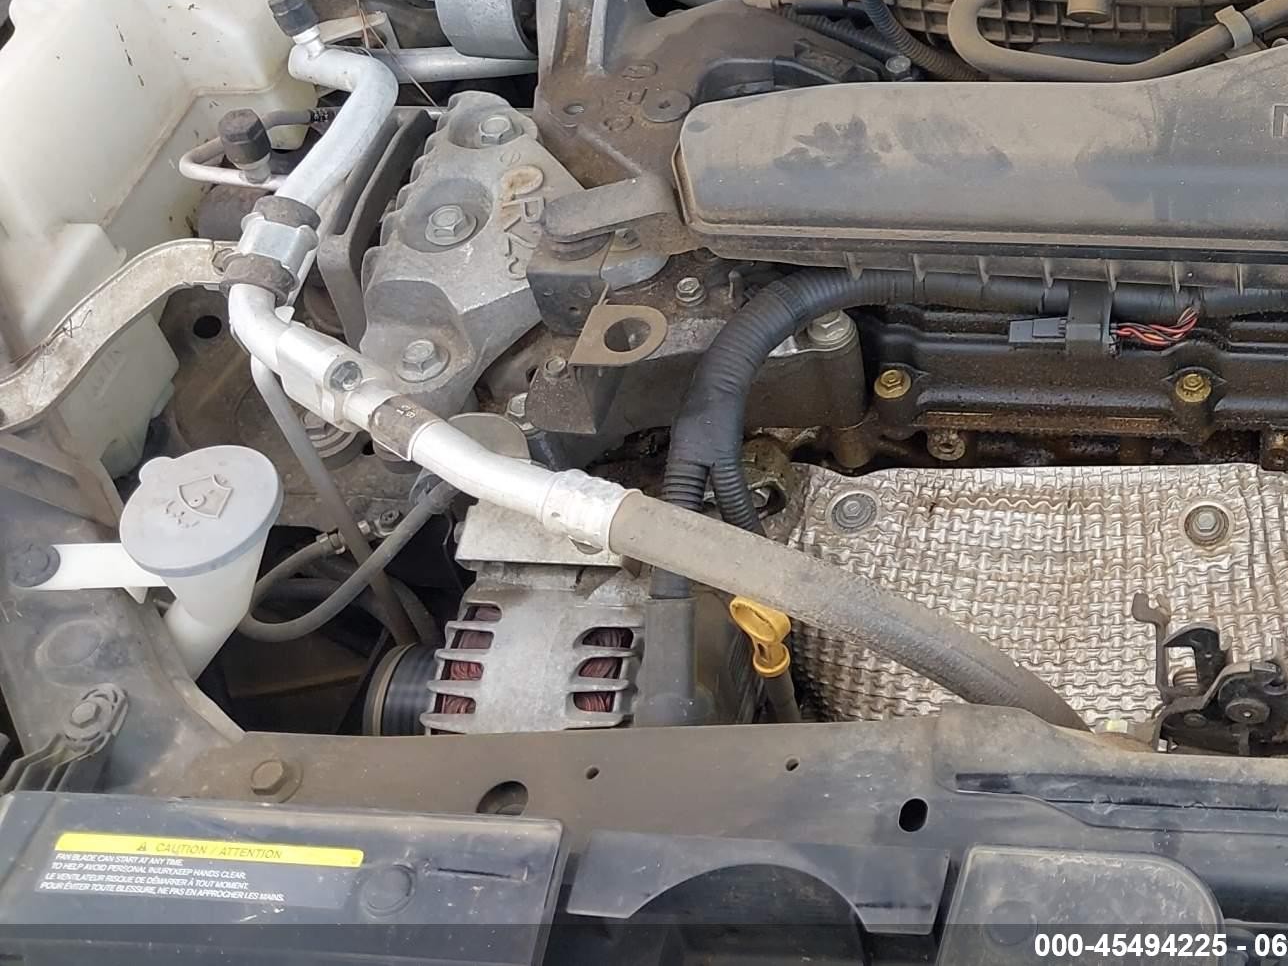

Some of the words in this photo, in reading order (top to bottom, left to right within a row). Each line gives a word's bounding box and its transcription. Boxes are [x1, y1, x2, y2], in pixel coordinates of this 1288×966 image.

[156, 842, 206, 854] CAUTION
[218, 847, 283, 859] ATTENTION
[52, 862, 62, 870] TO
[62, 862, 84, 870] HELP
[84, 864, 108, 872] AVOID
[106, 864, 148, 874] PERSONAL
[194, 869, 219, 878] HANDS
[57, 873, 104, 882] VENTILATEUR
[104, 874, 134, 884] RISQUE
[195, 880, 216, 888] TOUT
[40, 882, 63, 890] POUR
[91, 884, 116, 892] TOUTE
[171, 888, 186, 896] PAS
[196, 890, 244, 900] APPROCHER
[244, 892, 260, 900] LES
